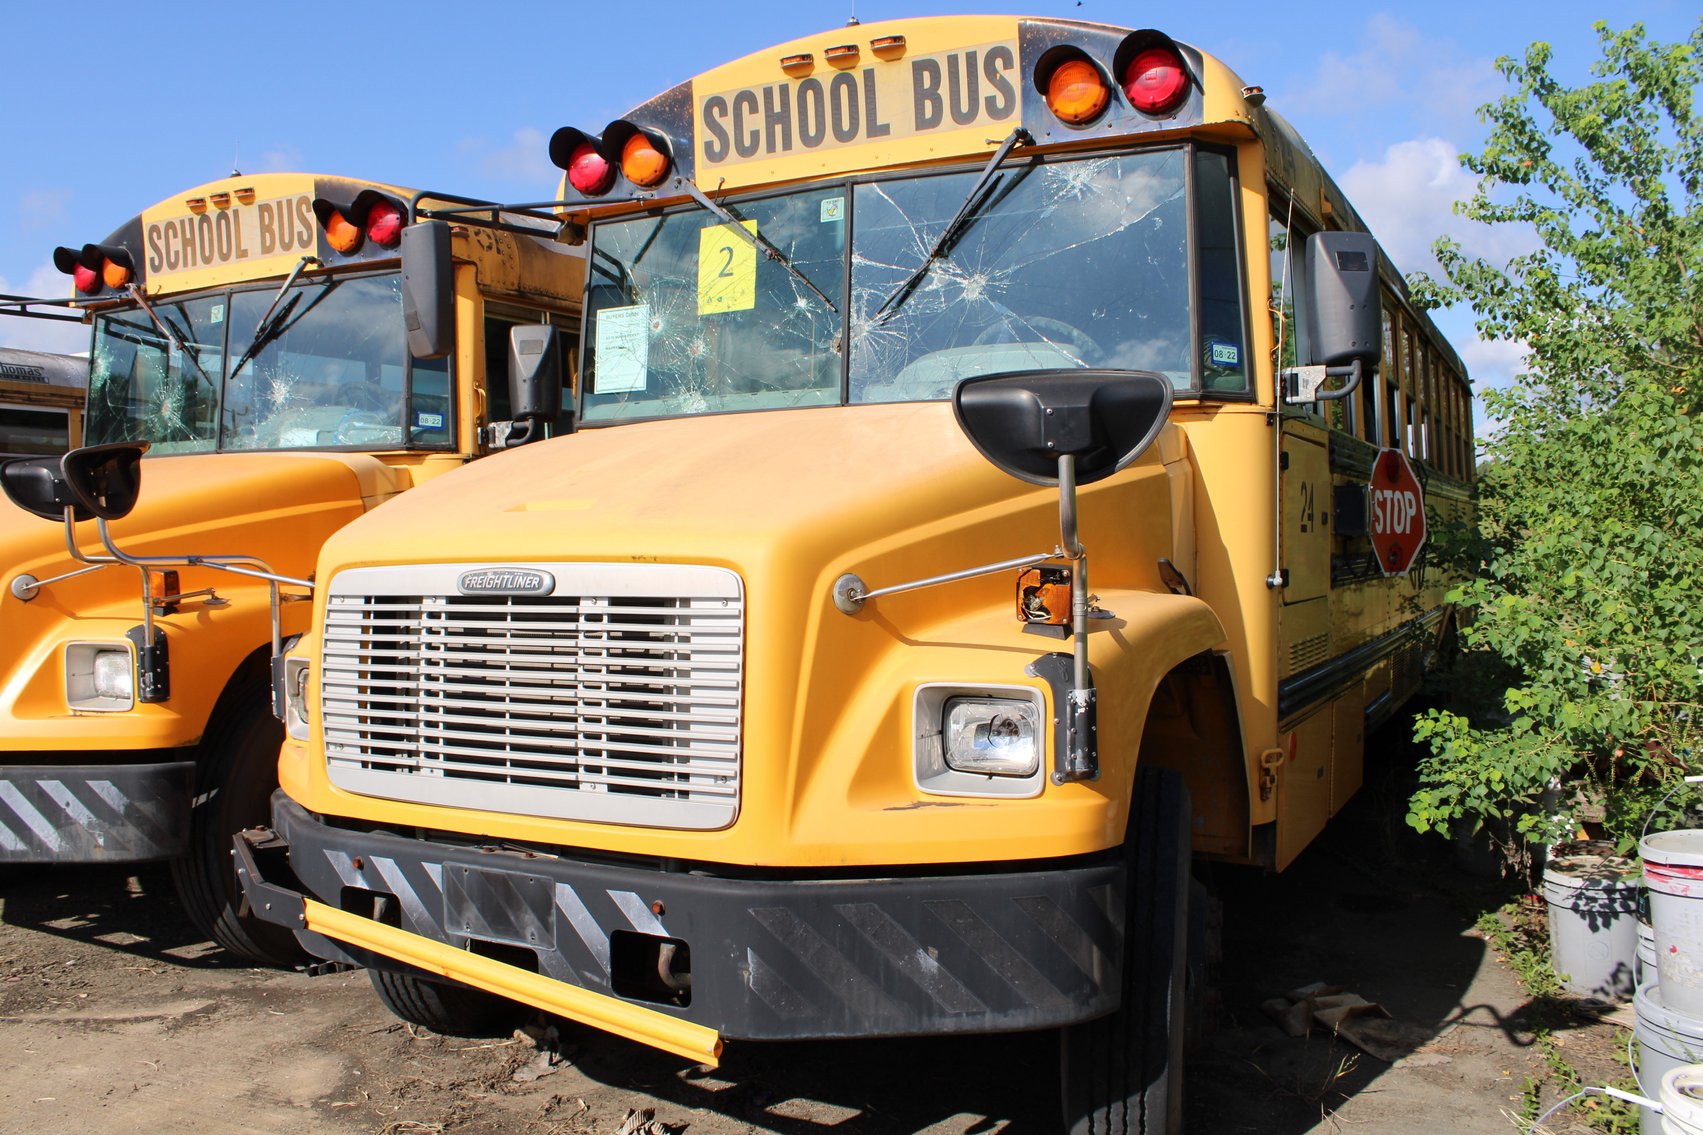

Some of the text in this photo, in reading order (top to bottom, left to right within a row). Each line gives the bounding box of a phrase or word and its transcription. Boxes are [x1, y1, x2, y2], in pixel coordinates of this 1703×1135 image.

[703, 45, 1017, 163] SCHOOL BUS
[147, 195, 314, 274] SCHOOL BUS
[719, 246, 734, 278] 2
[0, 361, 42, 377] homas
[1300, 481, 1314, 534] 24
[1374, 489, 1417, 535] STOP
[464, 573, 540, 590] FREIGHTLINER
